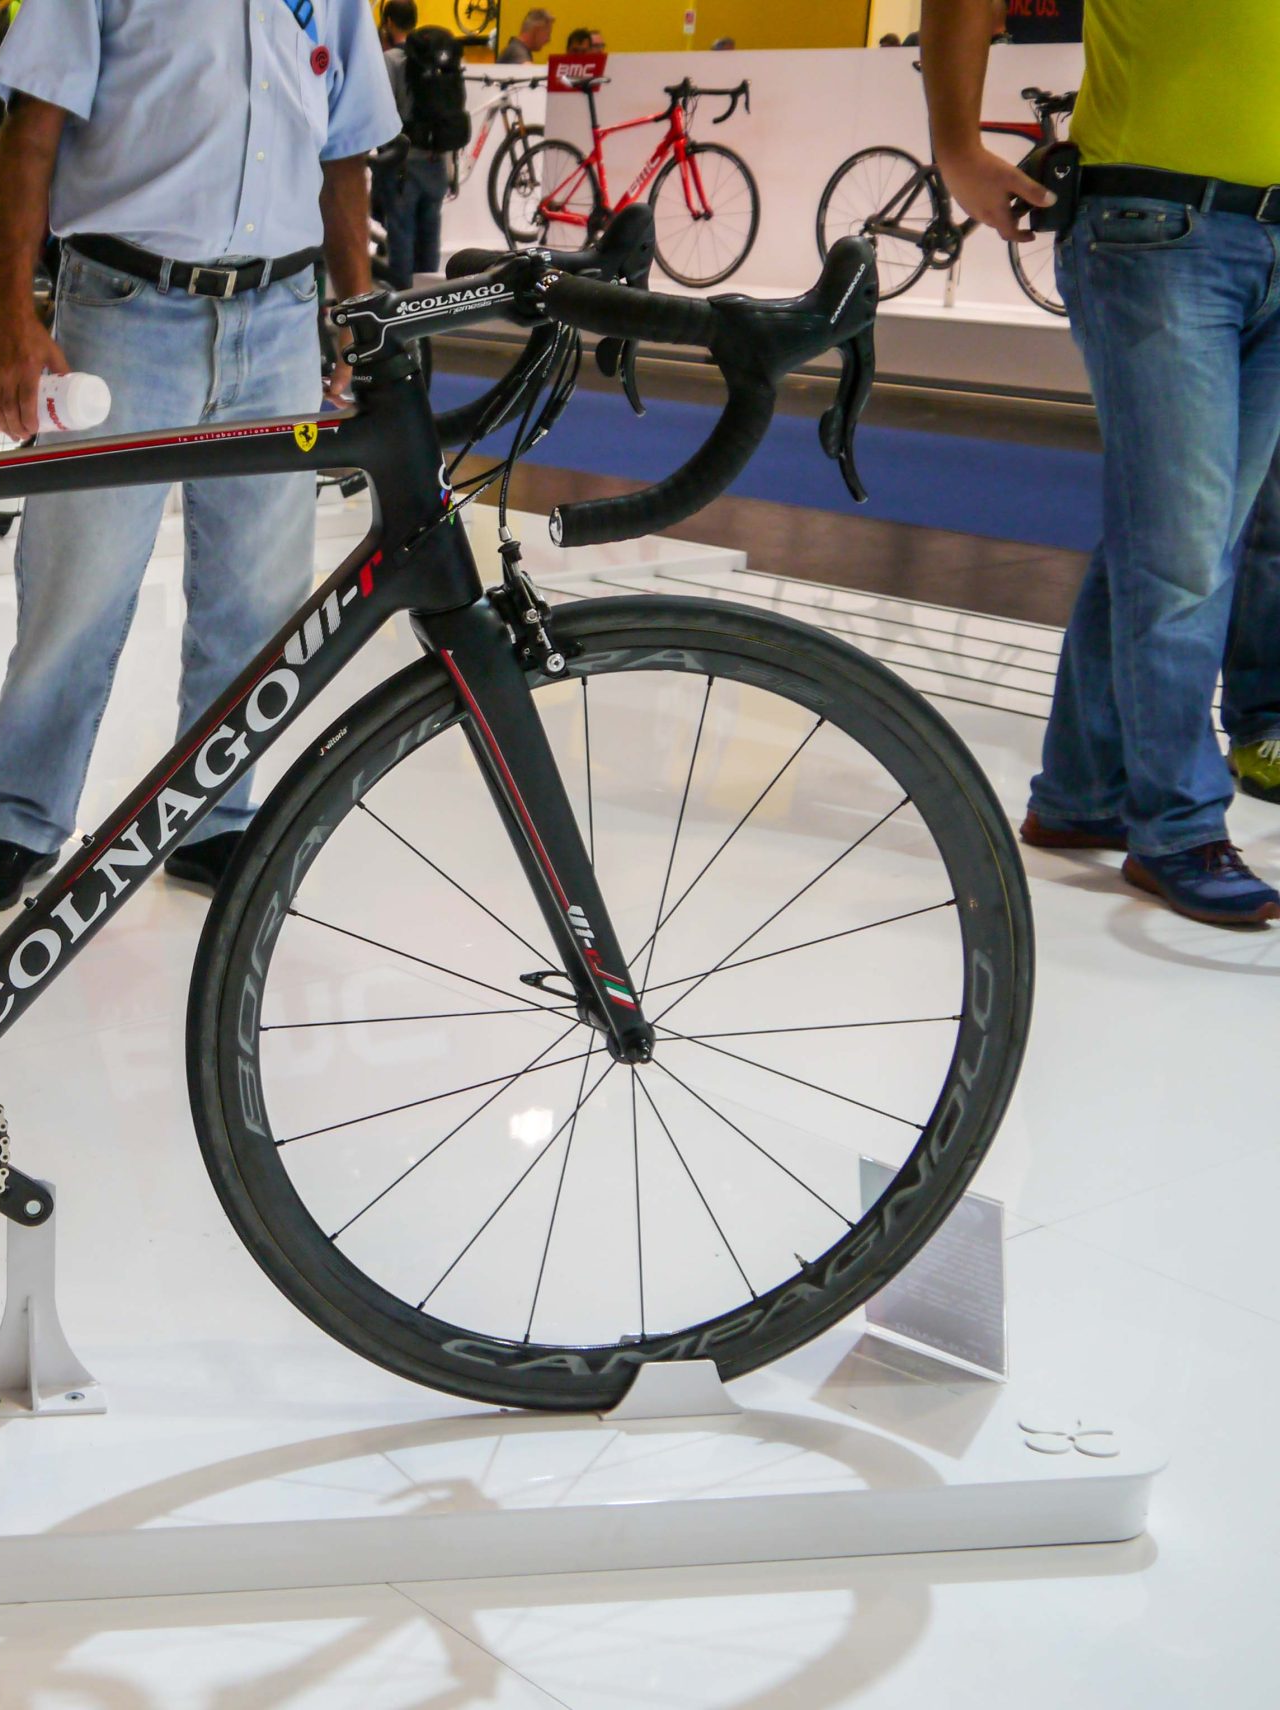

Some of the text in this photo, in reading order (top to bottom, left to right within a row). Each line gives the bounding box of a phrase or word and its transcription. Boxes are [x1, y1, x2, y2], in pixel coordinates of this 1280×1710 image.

[556, 63, 596, 78] BMC
[408, 283, 505, 312] COLNAGO
[236, 815, 332, 1138] BORA
